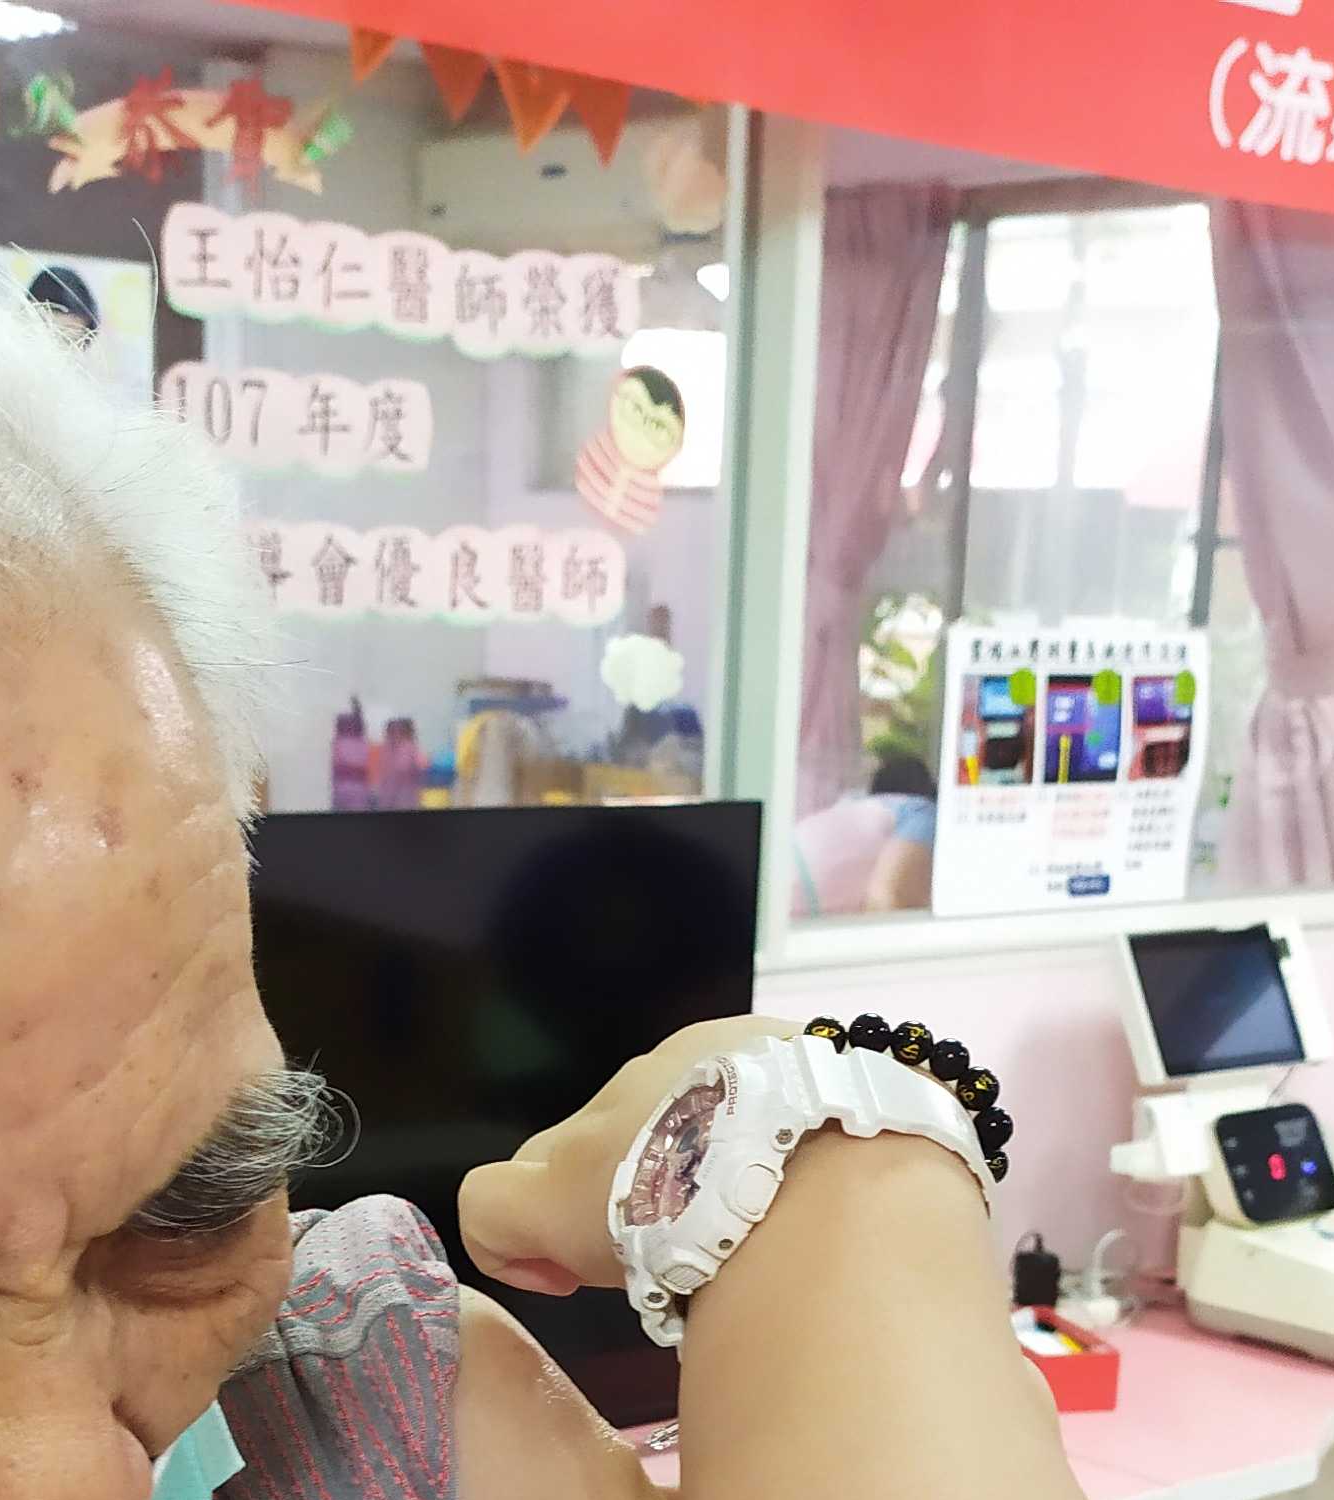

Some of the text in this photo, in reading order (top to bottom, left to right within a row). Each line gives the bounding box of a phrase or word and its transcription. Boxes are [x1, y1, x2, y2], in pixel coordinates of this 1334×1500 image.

[176, 226, 623, 340] 王怡仁醫師榮獲
